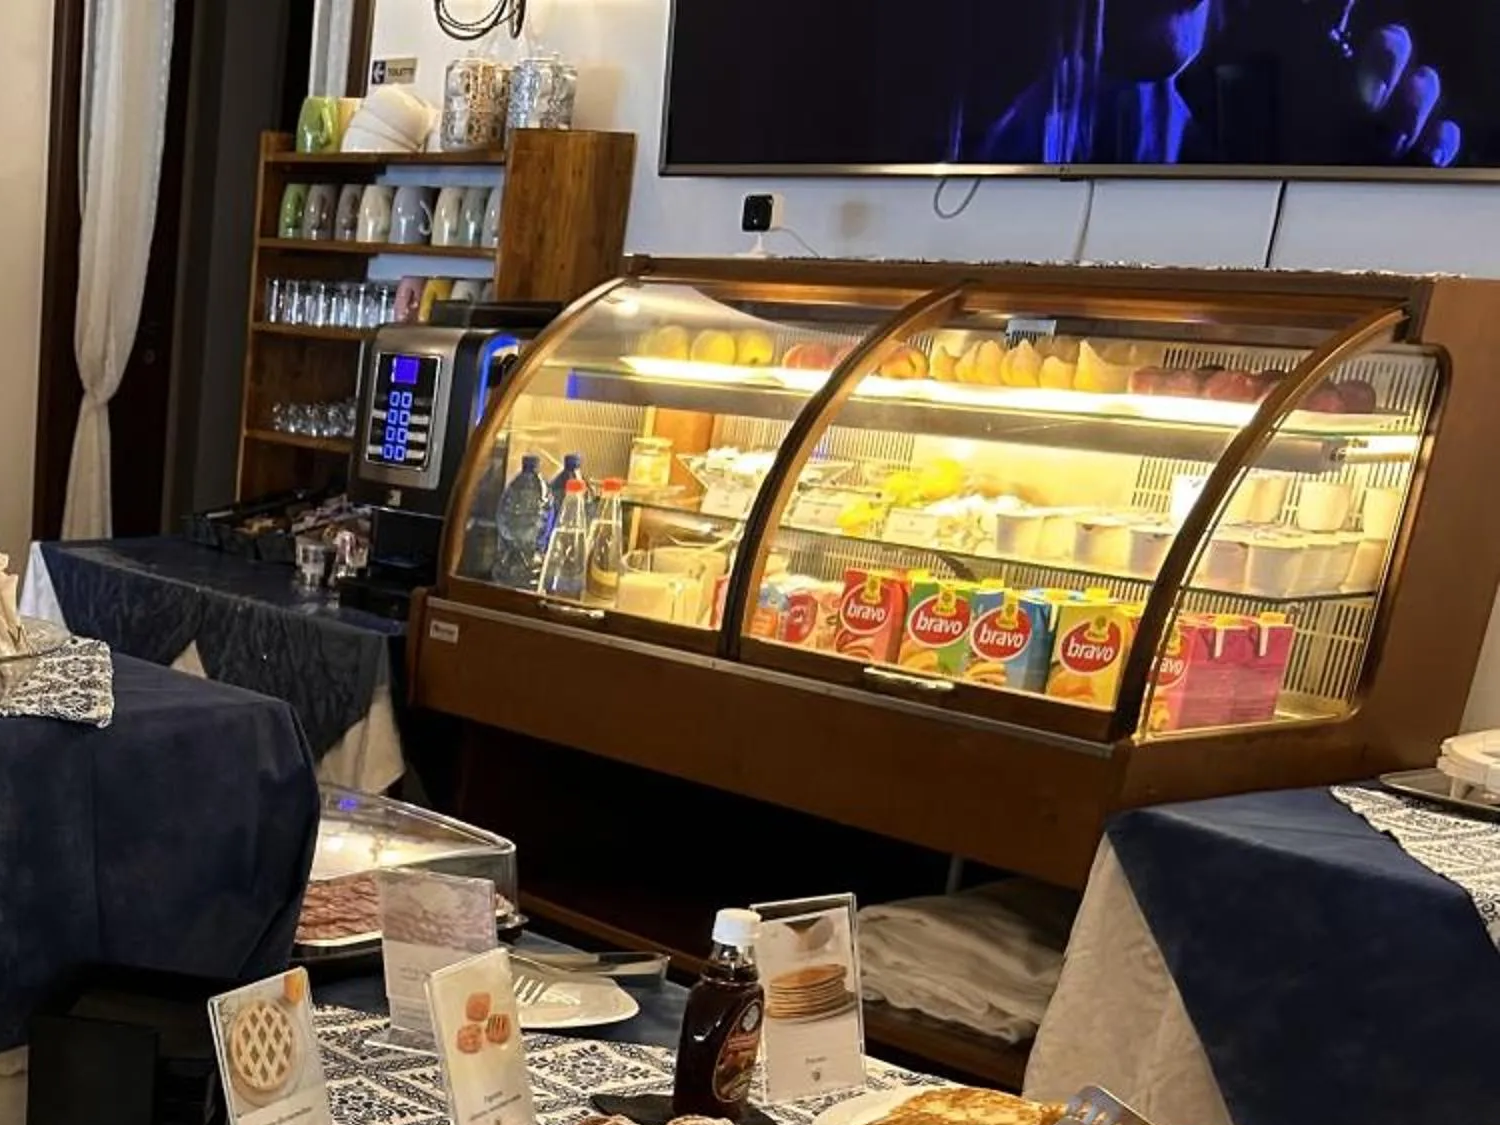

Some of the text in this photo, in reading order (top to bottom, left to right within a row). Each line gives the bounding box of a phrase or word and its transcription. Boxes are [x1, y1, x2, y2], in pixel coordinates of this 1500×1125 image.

[846, 597, 887, 622] bravo
[915, 611, 963, 635] bravo
[979, 623, 1025, 648] bravo
[1067, 636, 1115, 662] bravo
[1159, 657, 1184, 675] avo
